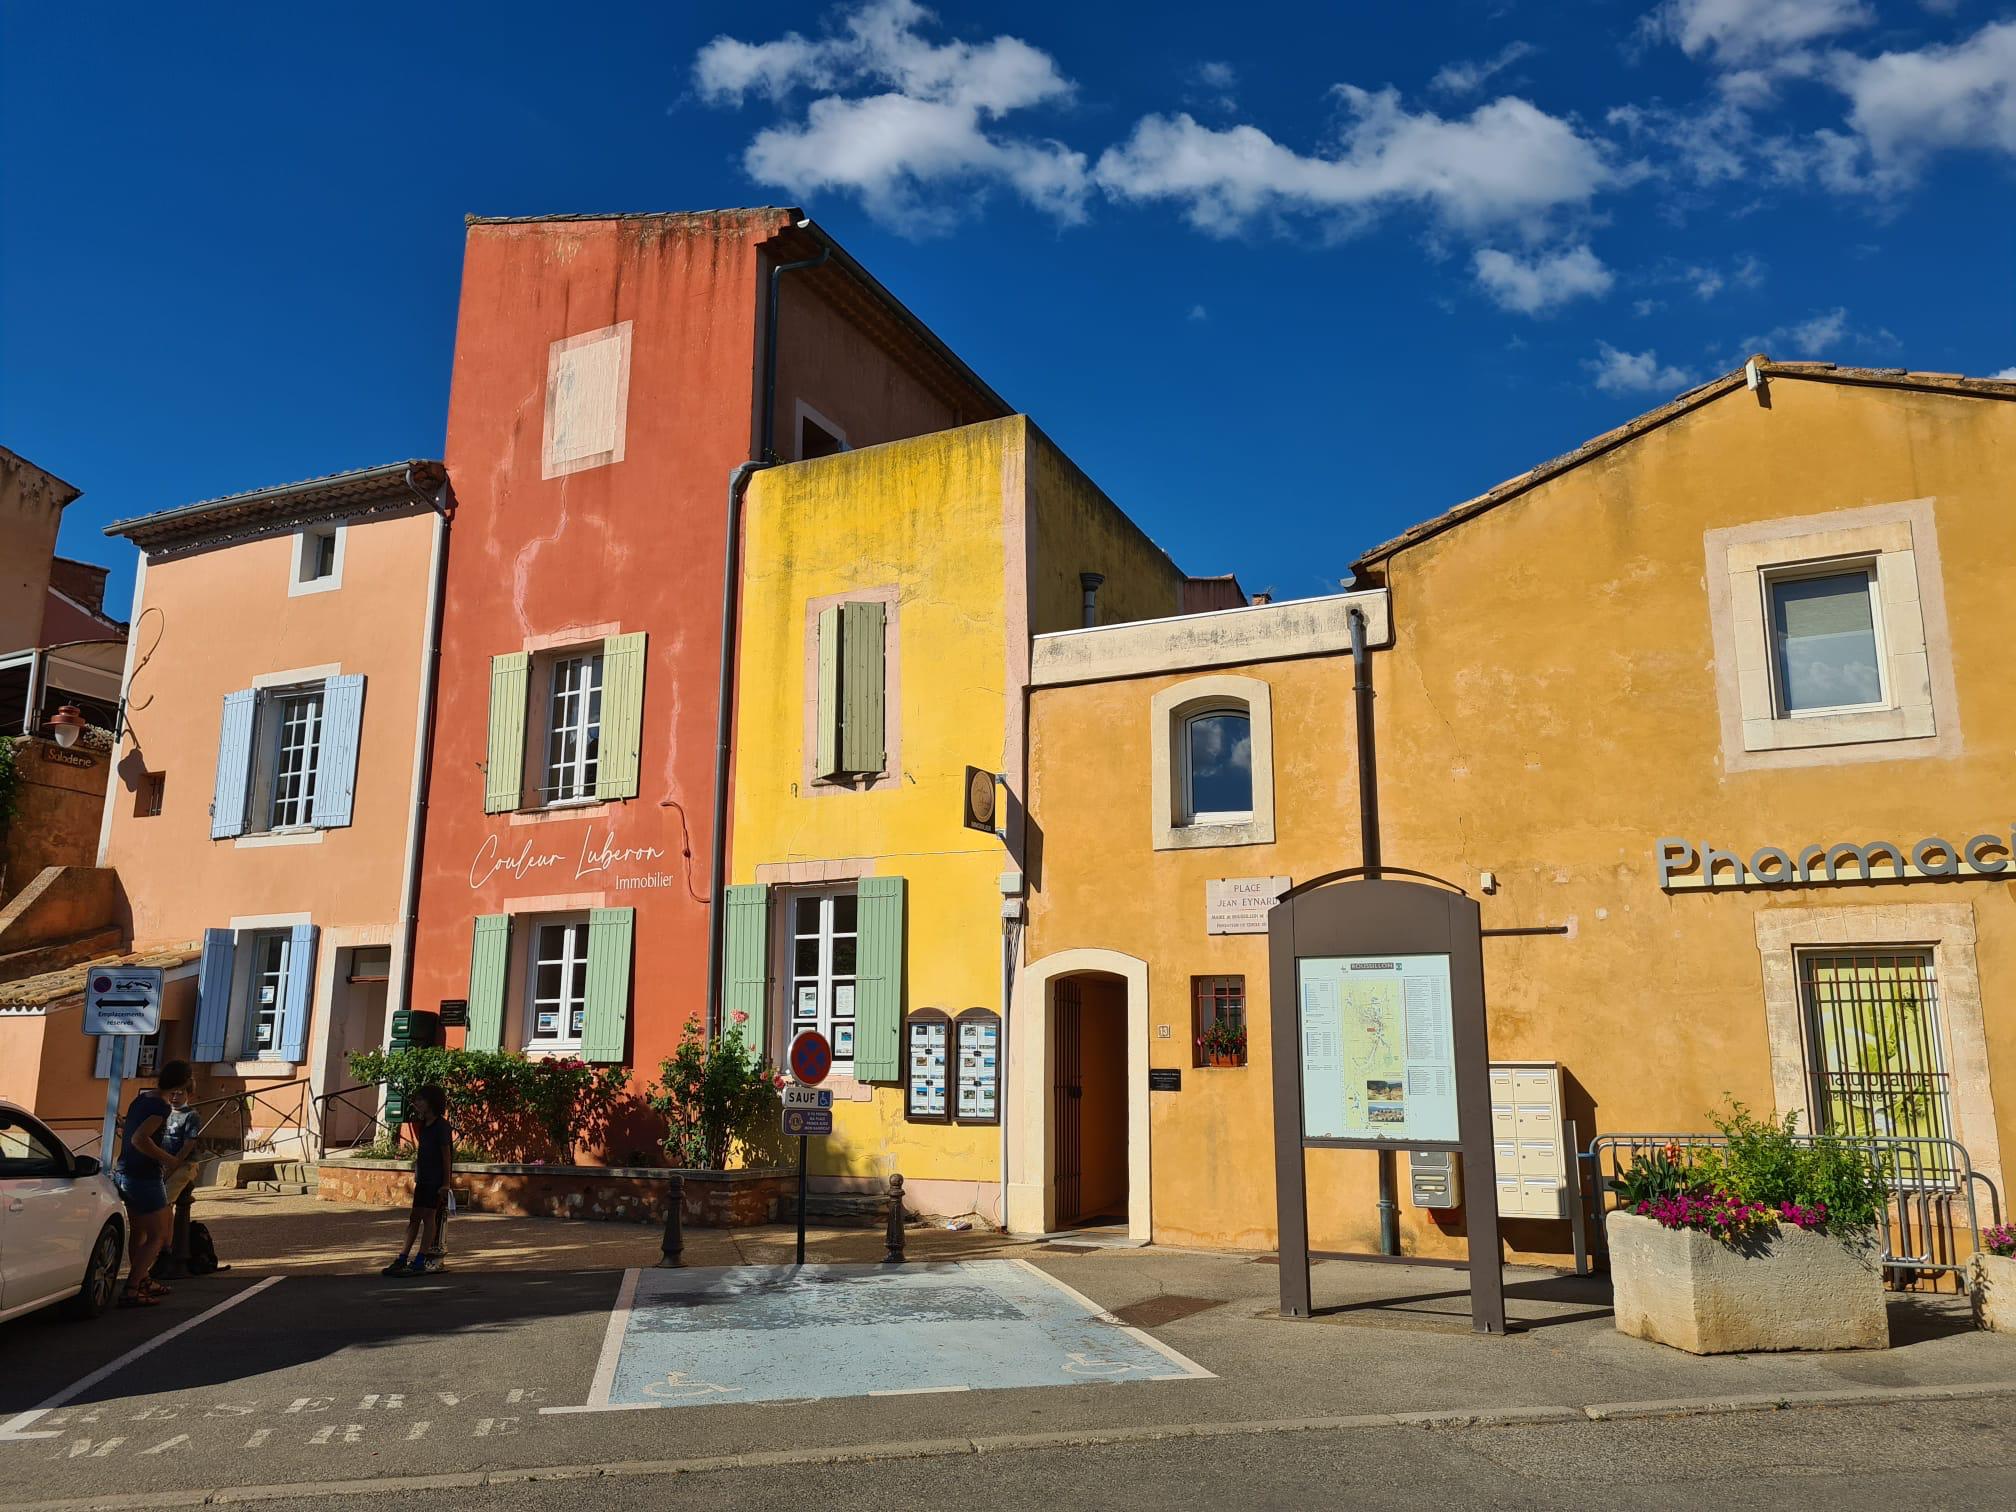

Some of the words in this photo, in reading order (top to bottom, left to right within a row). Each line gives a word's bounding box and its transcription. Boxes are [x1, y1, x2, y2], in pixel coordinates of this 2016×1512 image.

[469, 834, 566, 889] Couleur
[574, 825, 665, 880] Luberon
[615, 872, 674, 890] Immobilier
[1233, 883, 1261, 893] PLACE
[1242, 897, 1278, 907] EYNARD
[788, 1091, 816, 1104] SAUF
[47, 1416, 521, 1461] MAIRIE
